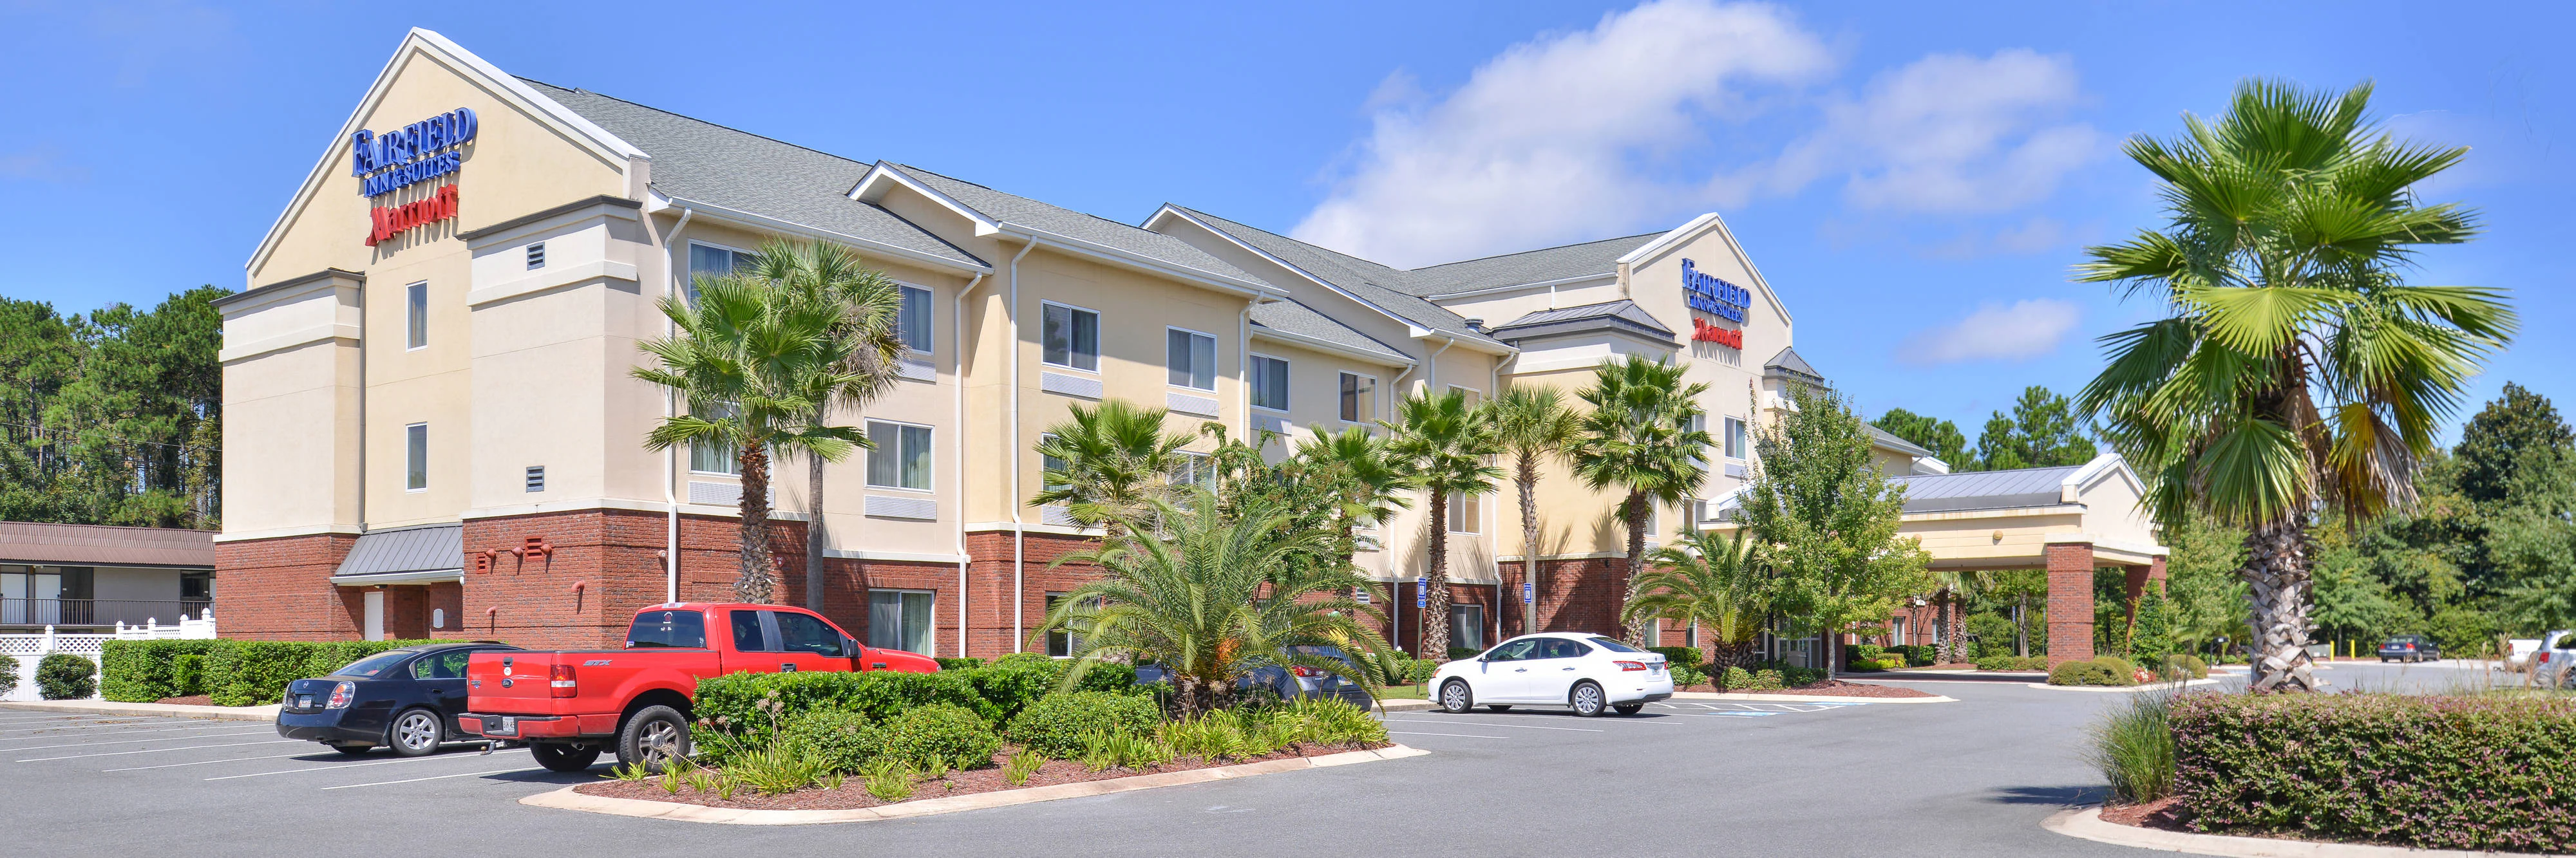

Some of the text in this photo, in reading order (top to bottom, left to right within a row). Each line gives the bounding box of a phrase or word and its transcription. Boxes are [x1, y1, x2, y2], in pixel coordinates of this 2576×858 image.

[351, 107, 478, 177] FAIRFIELD
[365, 183, 458, 247] Marriott
[1681, 257, 1751, 310] FAIRFIELD
[1691, 317, 1743, 350] Marriott
